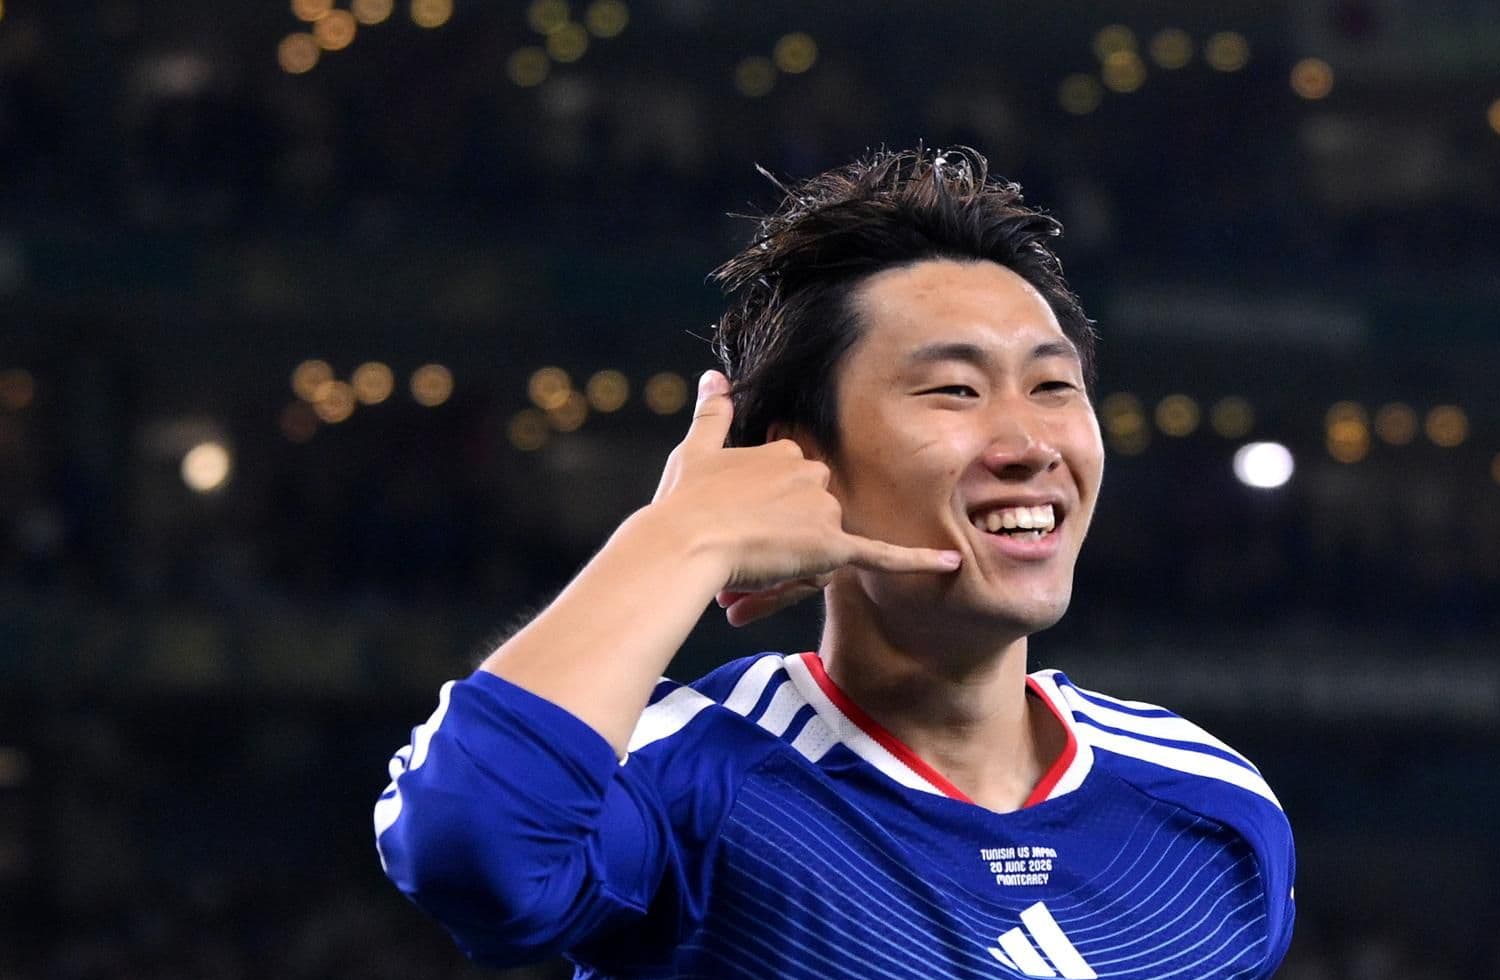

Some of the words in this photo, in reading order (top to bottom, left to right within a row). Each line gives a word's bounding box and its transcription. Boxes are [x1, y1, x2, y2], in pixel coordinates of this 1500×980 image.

[980, 848, 1015, 861] TUNISIA
[1031, 846, 1058, 858] JAPAN
[990, 861, 1003, 874] 20
[1004, 860, 1026, 873] JUNE
[1028, 859, 1053, 872] 2026
[996, 873, 1049, 886] MONTERREY
